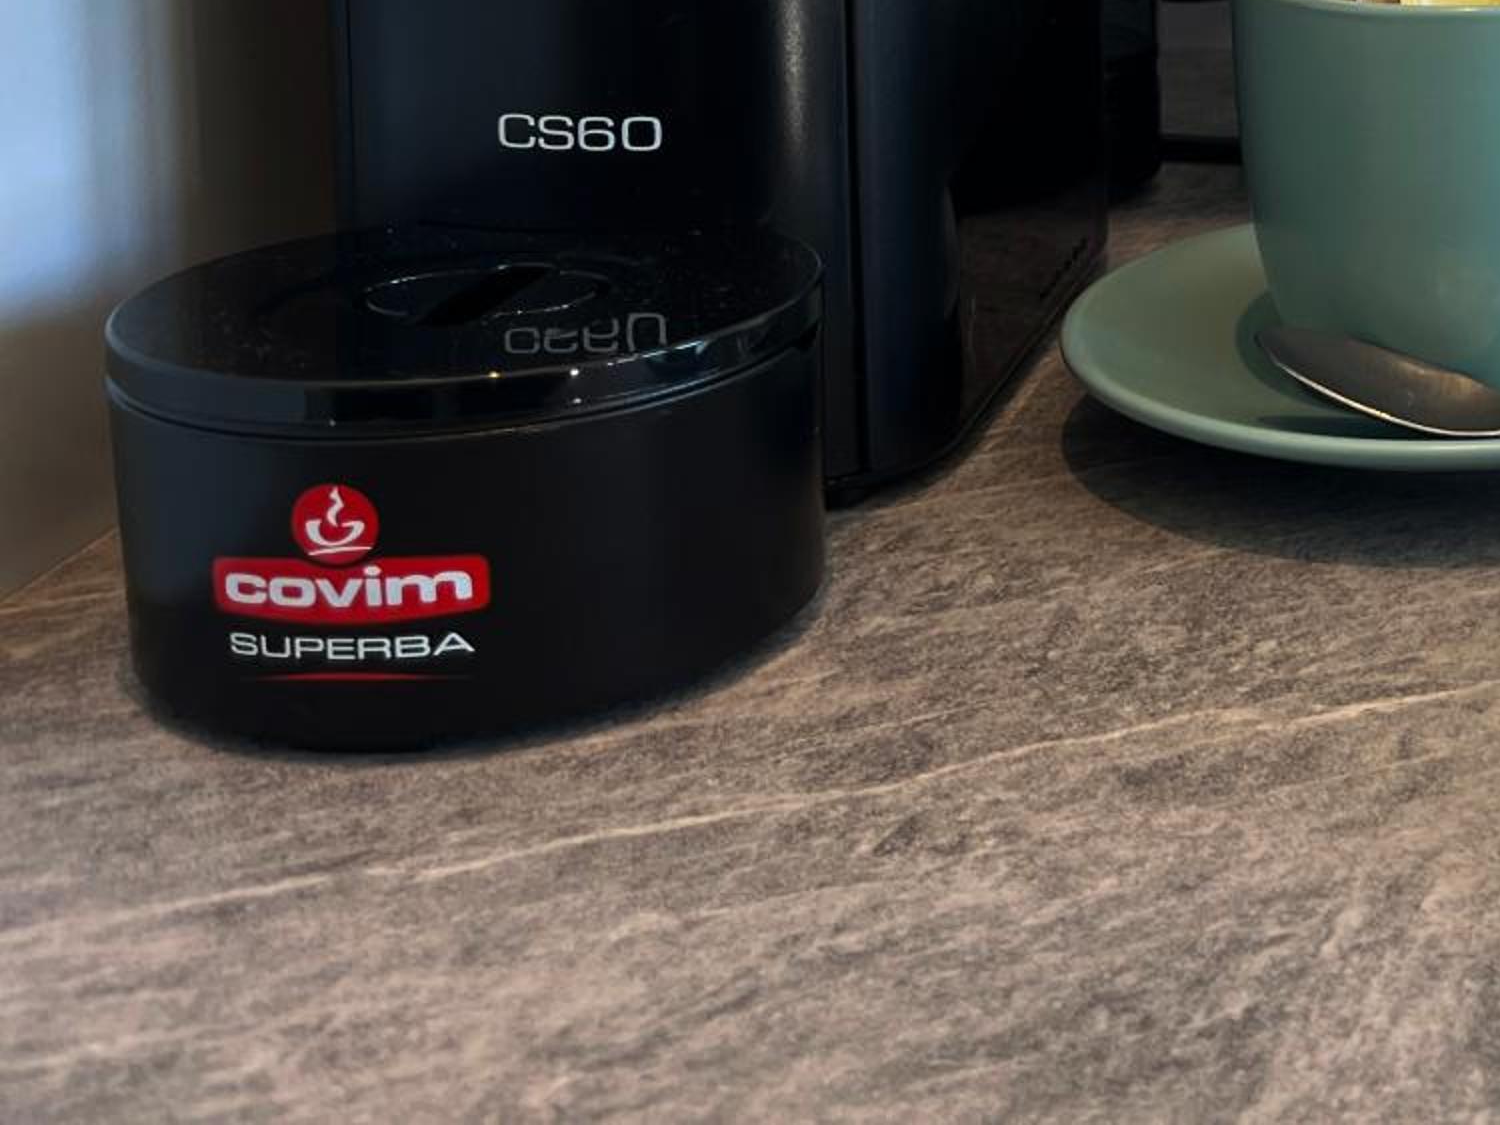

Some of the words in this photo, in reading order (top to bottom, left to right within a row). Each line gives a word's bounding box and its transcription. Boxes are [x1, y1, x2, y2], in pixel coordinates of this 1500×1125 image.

[498, 113, 662, 152] CS60
[224, 564, 473, 608] covim
[229, 631, 476, 660] SUPERBA
